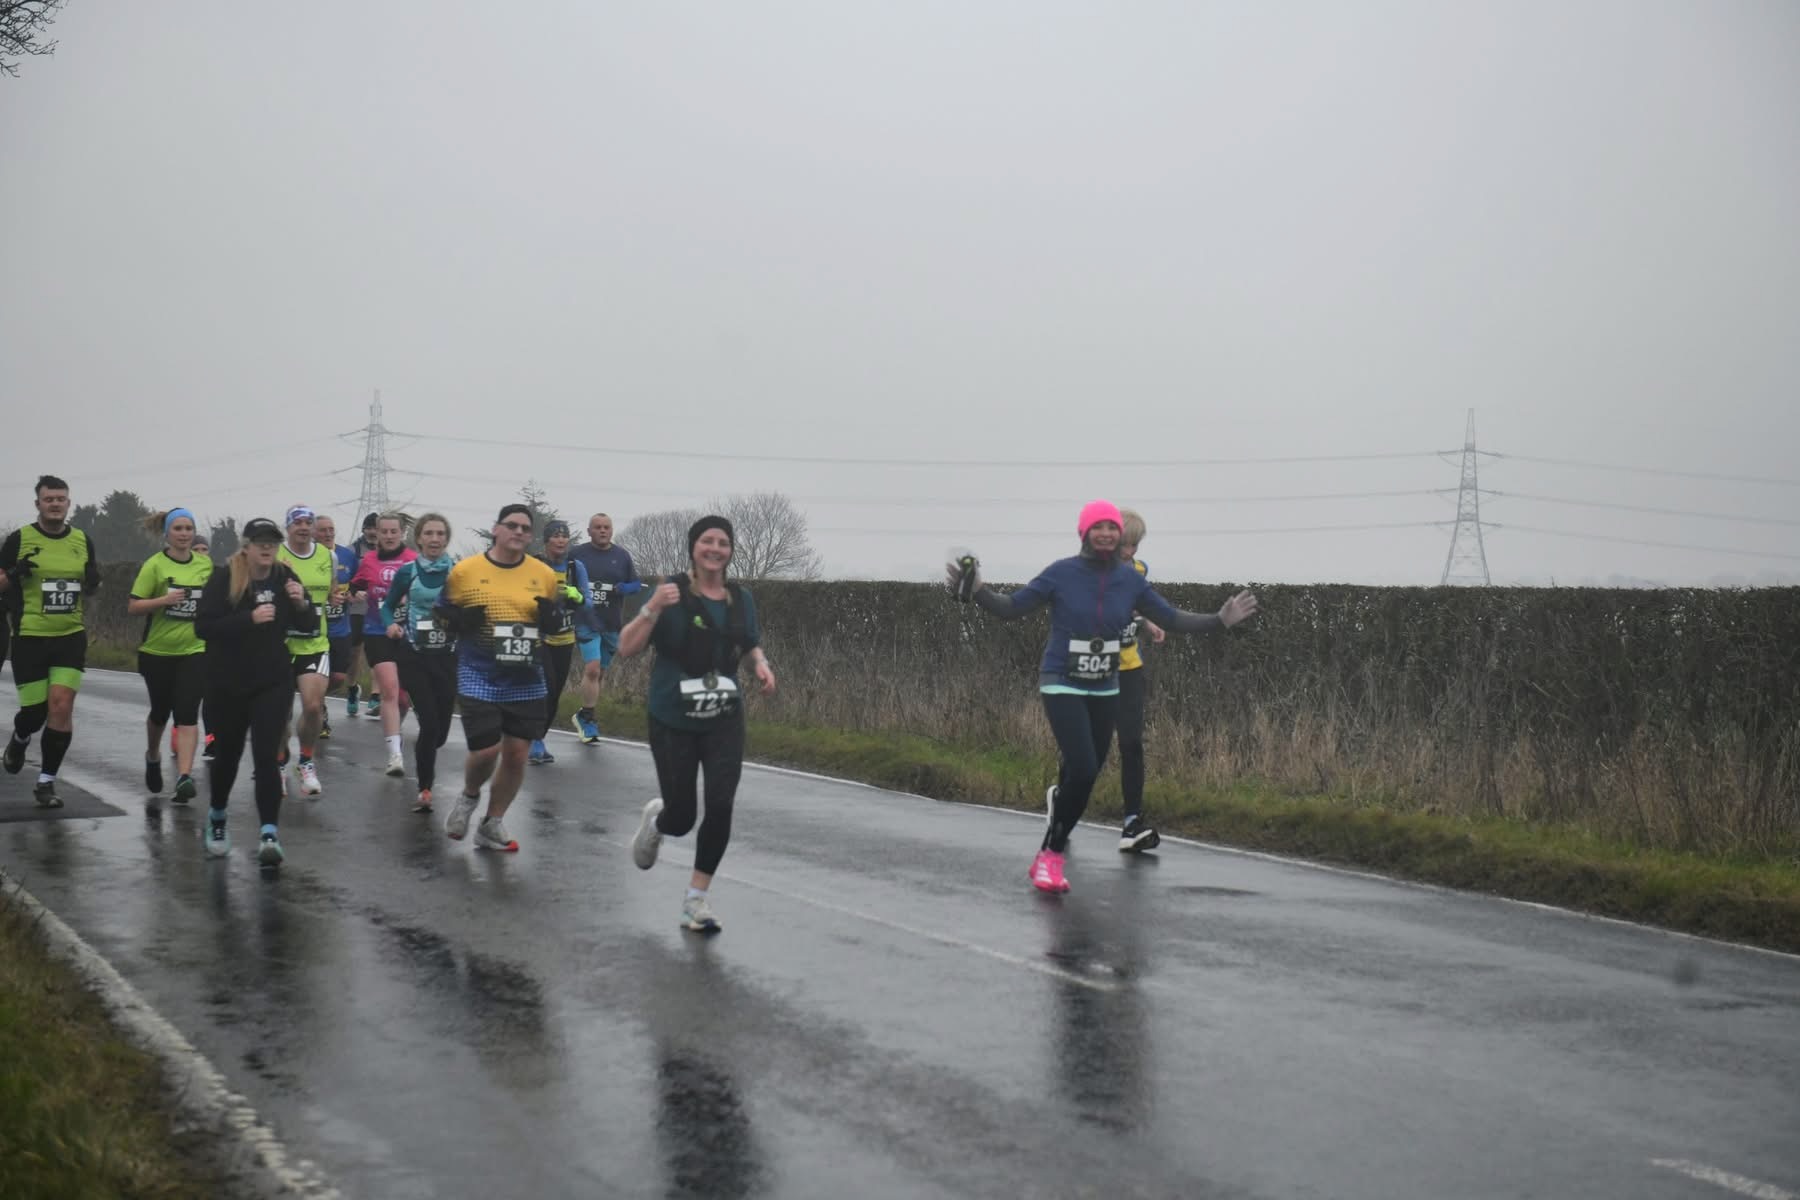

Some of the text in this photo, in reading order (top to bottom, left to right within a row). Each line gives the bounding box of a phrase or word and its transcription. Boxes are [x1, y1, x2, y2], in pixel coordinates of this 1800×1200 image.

[49, 592, 73, 605] 116
[502, 638, 531, 655] 138
[1077, 655, 1111, 672] 504
